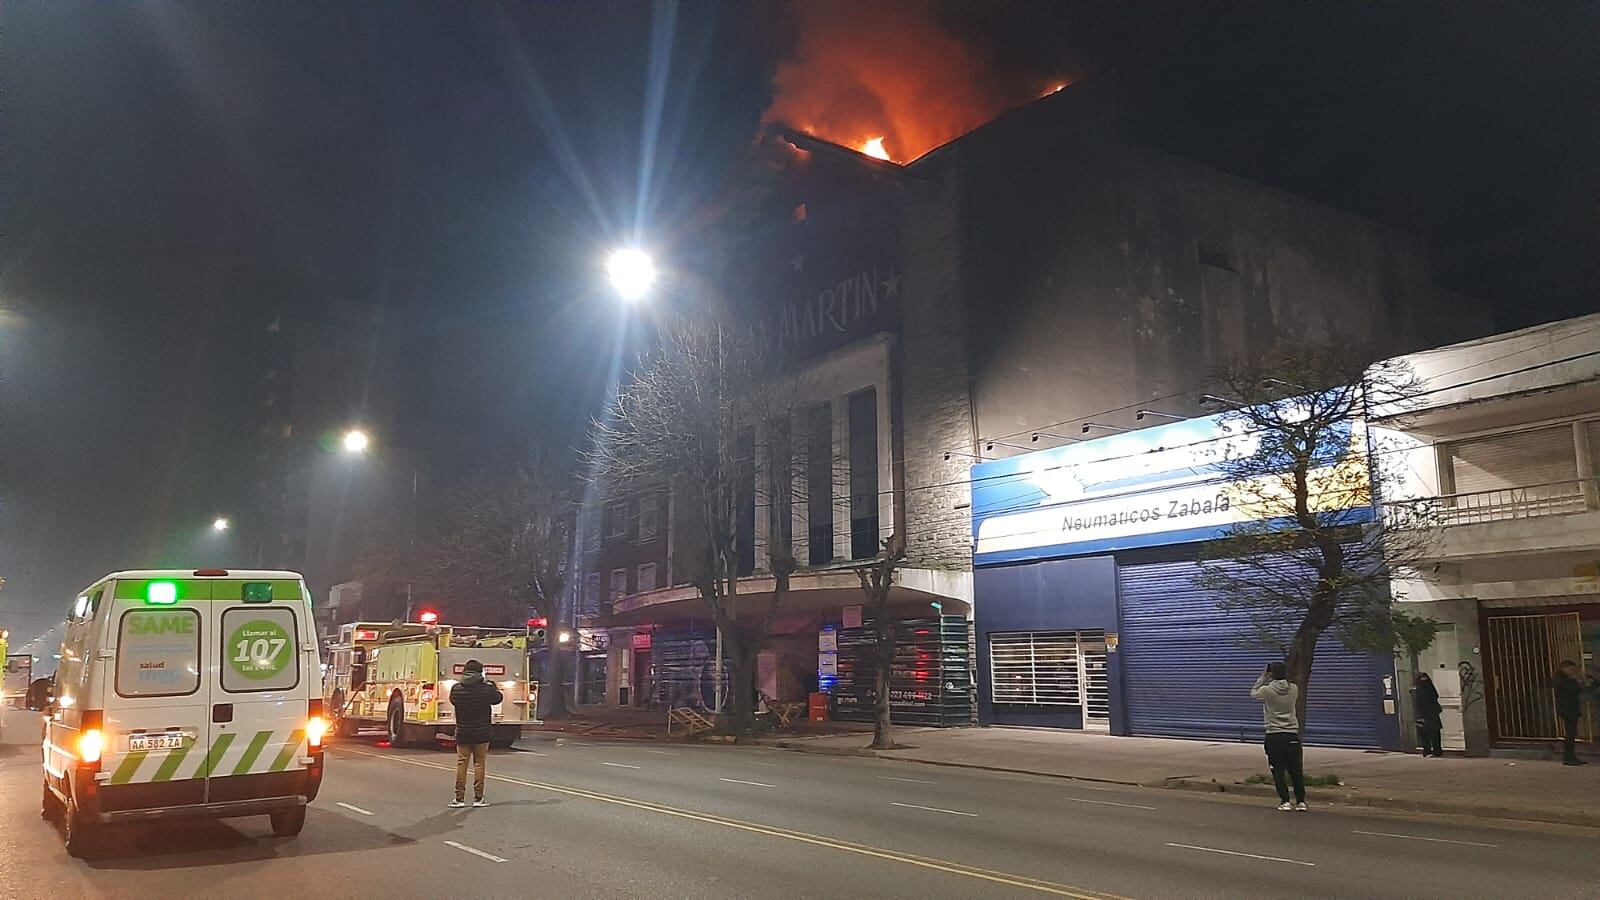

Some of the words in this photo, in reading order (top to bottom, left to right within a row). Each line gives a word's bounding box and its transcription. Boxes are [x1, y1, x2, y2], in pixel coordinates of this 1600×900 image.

[778, 264, 878, 351] MARTIN
[1167, 494, 1230, 519] Zabala
[128, 615, 194, 634] SAME
[242, 629, 268, 637] Llamar
[233, 638, 287, 662] 107
[139, 660, 165, 670] salud
[132, 740, 145, 750] AA
[147, 739, 165, 749] 582
[168, 738, 180, 748] ZA
